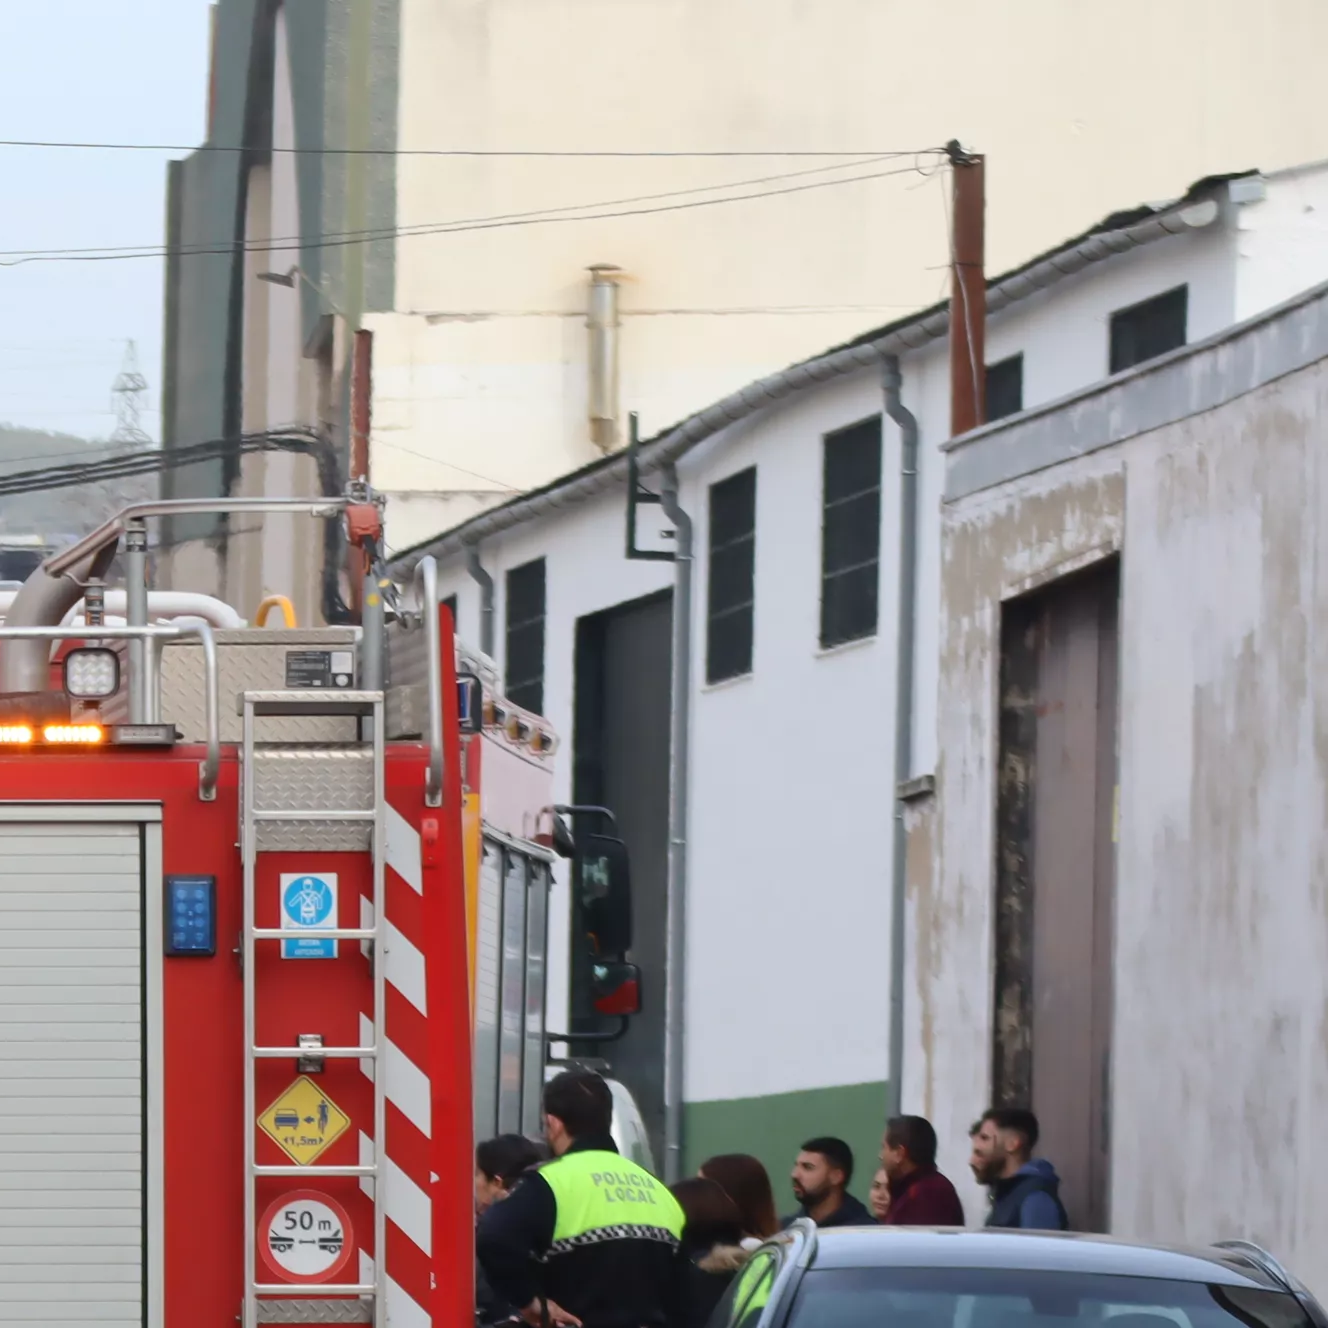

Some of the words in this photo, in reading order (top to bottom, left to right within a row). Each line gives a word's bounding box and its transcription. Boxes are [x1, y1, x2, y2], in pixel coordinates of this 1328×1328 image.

[590, 1172, 655, 1189] POLICIA
[605, 1187, 657, 1205] LOCAL
[285, 1211, 313, 1230] 50
[318, 1220, 332, 1230] m
